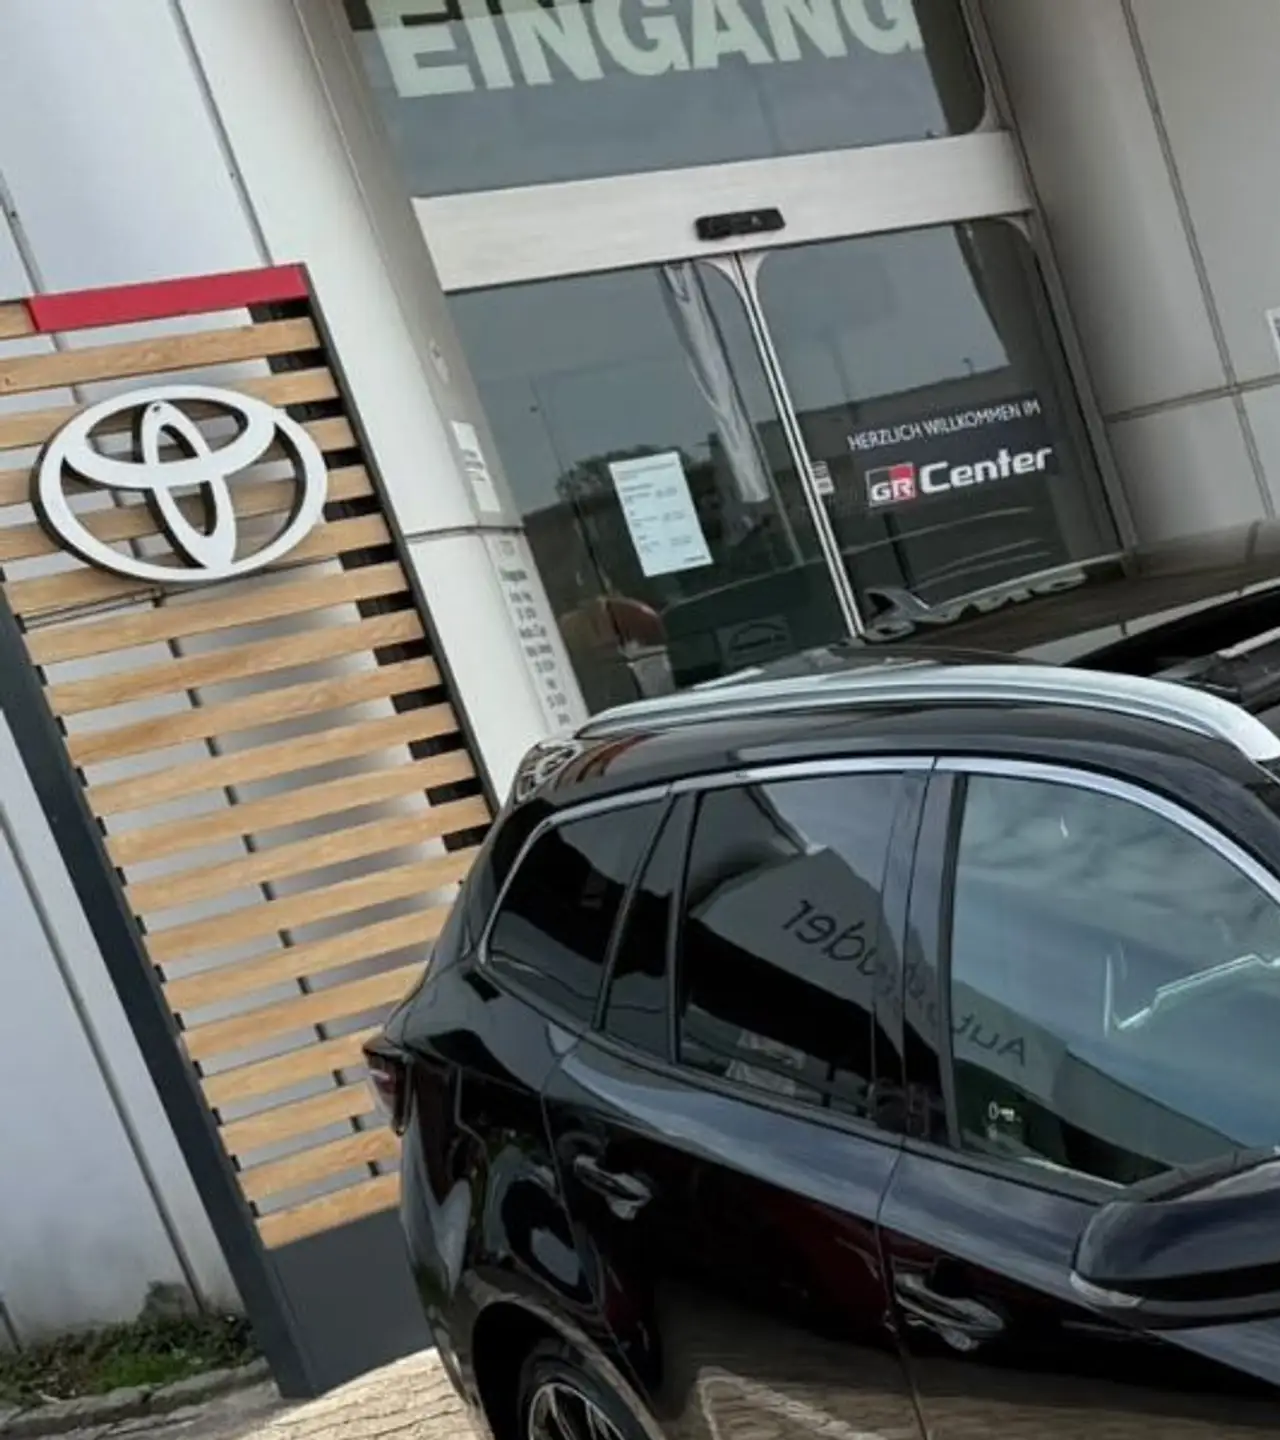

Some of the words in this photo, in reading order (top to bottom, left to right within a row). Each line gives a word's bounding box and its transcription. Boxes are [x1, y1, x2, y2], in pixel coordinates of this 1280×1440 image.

[374, 0, 924, 98] EINGANG
[848, 424, 922, 451] HERZLICH
[922, 403, 1022, 435] WILLKOMMEN
[1023, 399, 1042, 416] IM
[870, 477, 914, 502] GR
[919, 447, 1053, 494] Center
